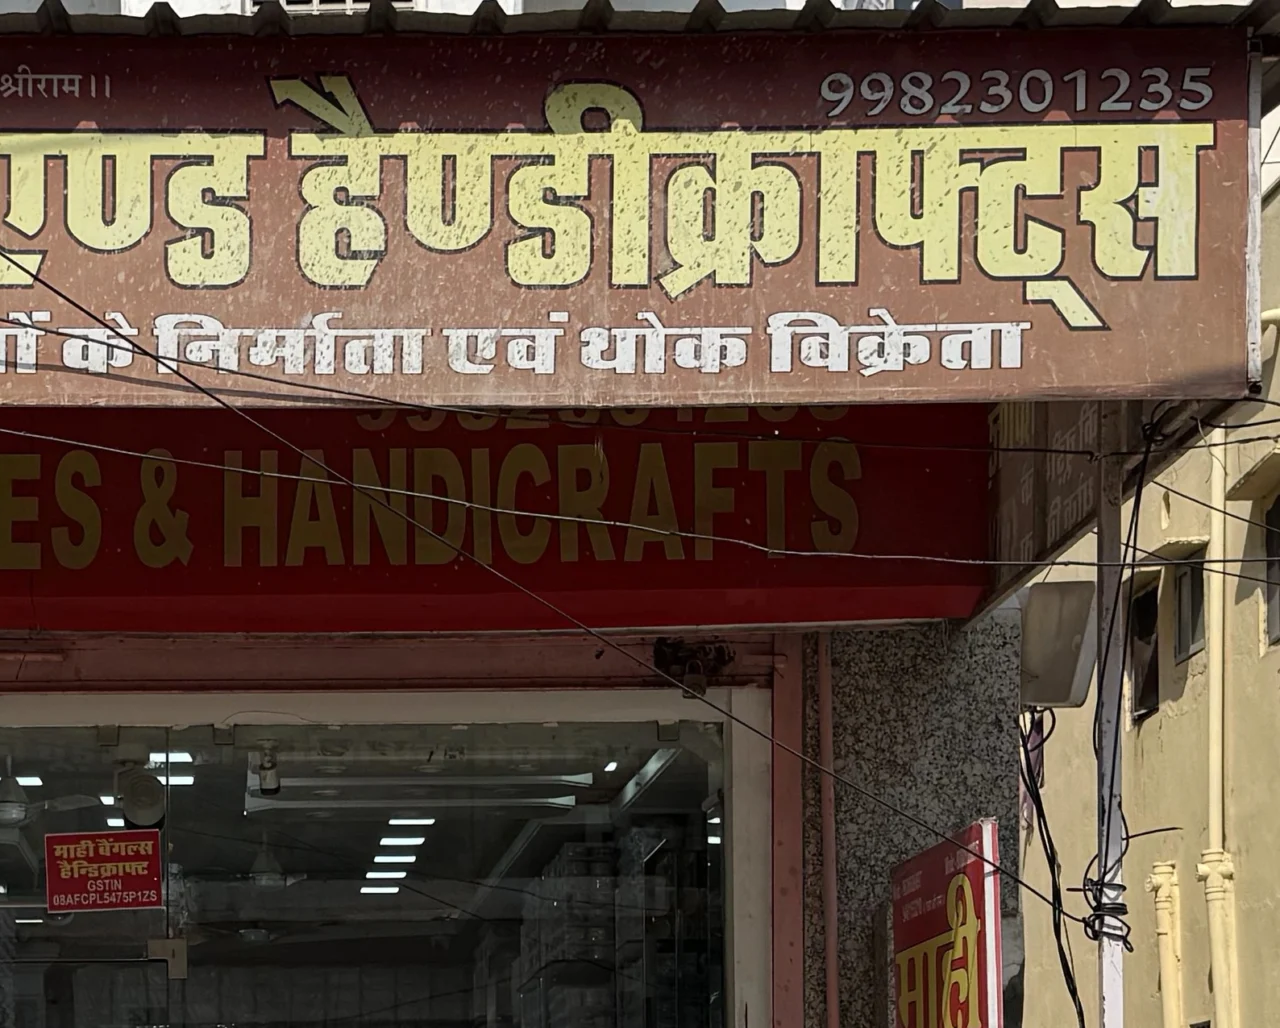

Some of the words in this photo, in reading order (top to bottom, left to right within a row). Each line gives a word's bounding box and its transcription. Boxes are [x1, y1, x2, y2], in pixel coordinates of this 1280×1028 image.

[820, 67, 1215, 118] 9982301235
[266, 71, 1216, 331] हैण्डीक्राफ्ट्स
[57, 311, 140, 374] के
[152, 311, 434, 376] निर्माता
[442, 311, 571, 375] एवं
[581, 311, 752, 375] थोक
[766, 308, 1034, 378] विक्रेता
[133, 449, 195, 568] &
[222, 437, 864, 568] HANDICRAFTS
[53, 840, 96, 860] माही
[87, 879, 122, 892] GSTIN
